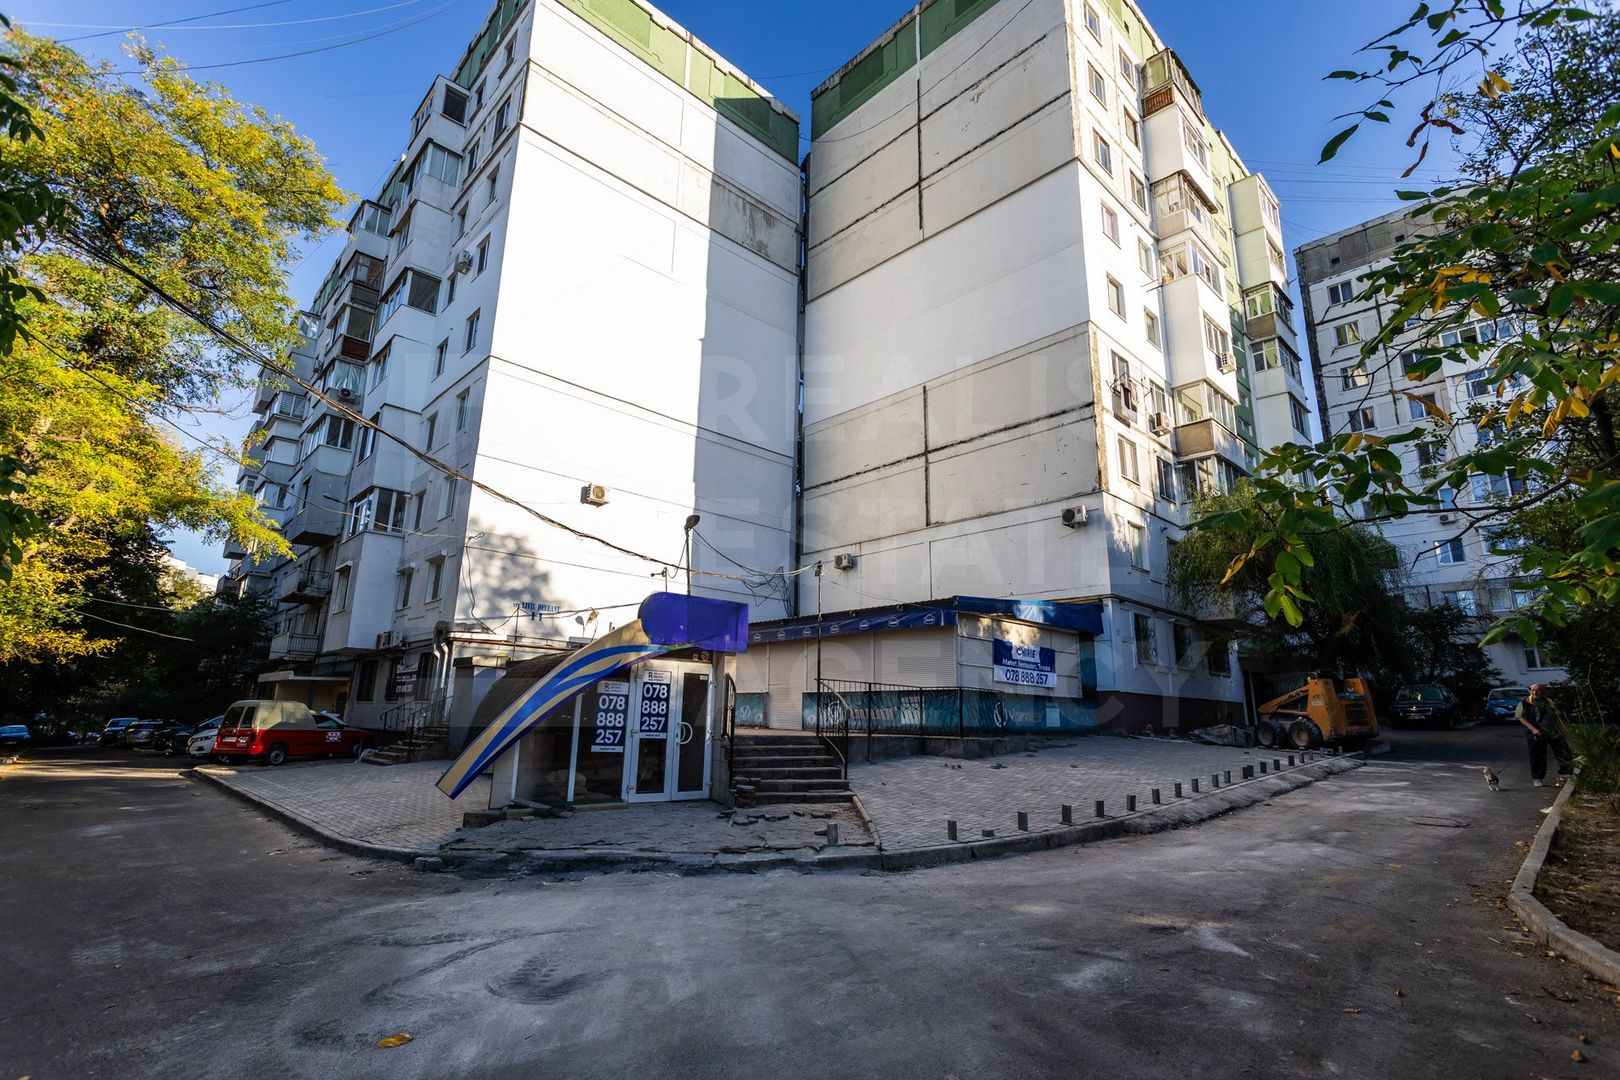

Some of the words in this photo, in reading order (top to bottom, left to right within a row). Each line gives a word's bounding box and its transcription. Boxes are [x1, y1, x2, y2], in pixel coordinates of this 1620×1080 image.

[1005, 668, 1019, 682] 078
[1021, 671, 1034, 684] 888
[1036, 673, 1048, 685] 257
[643, 684, 668, 699] 078
[598, 695, 626, 710] 078
[641, 700, 667, 715] 888
[596, 712, 624, 727] 888
[641, 717, 666, 731] 257
[595, 729, 622, 744] 257
